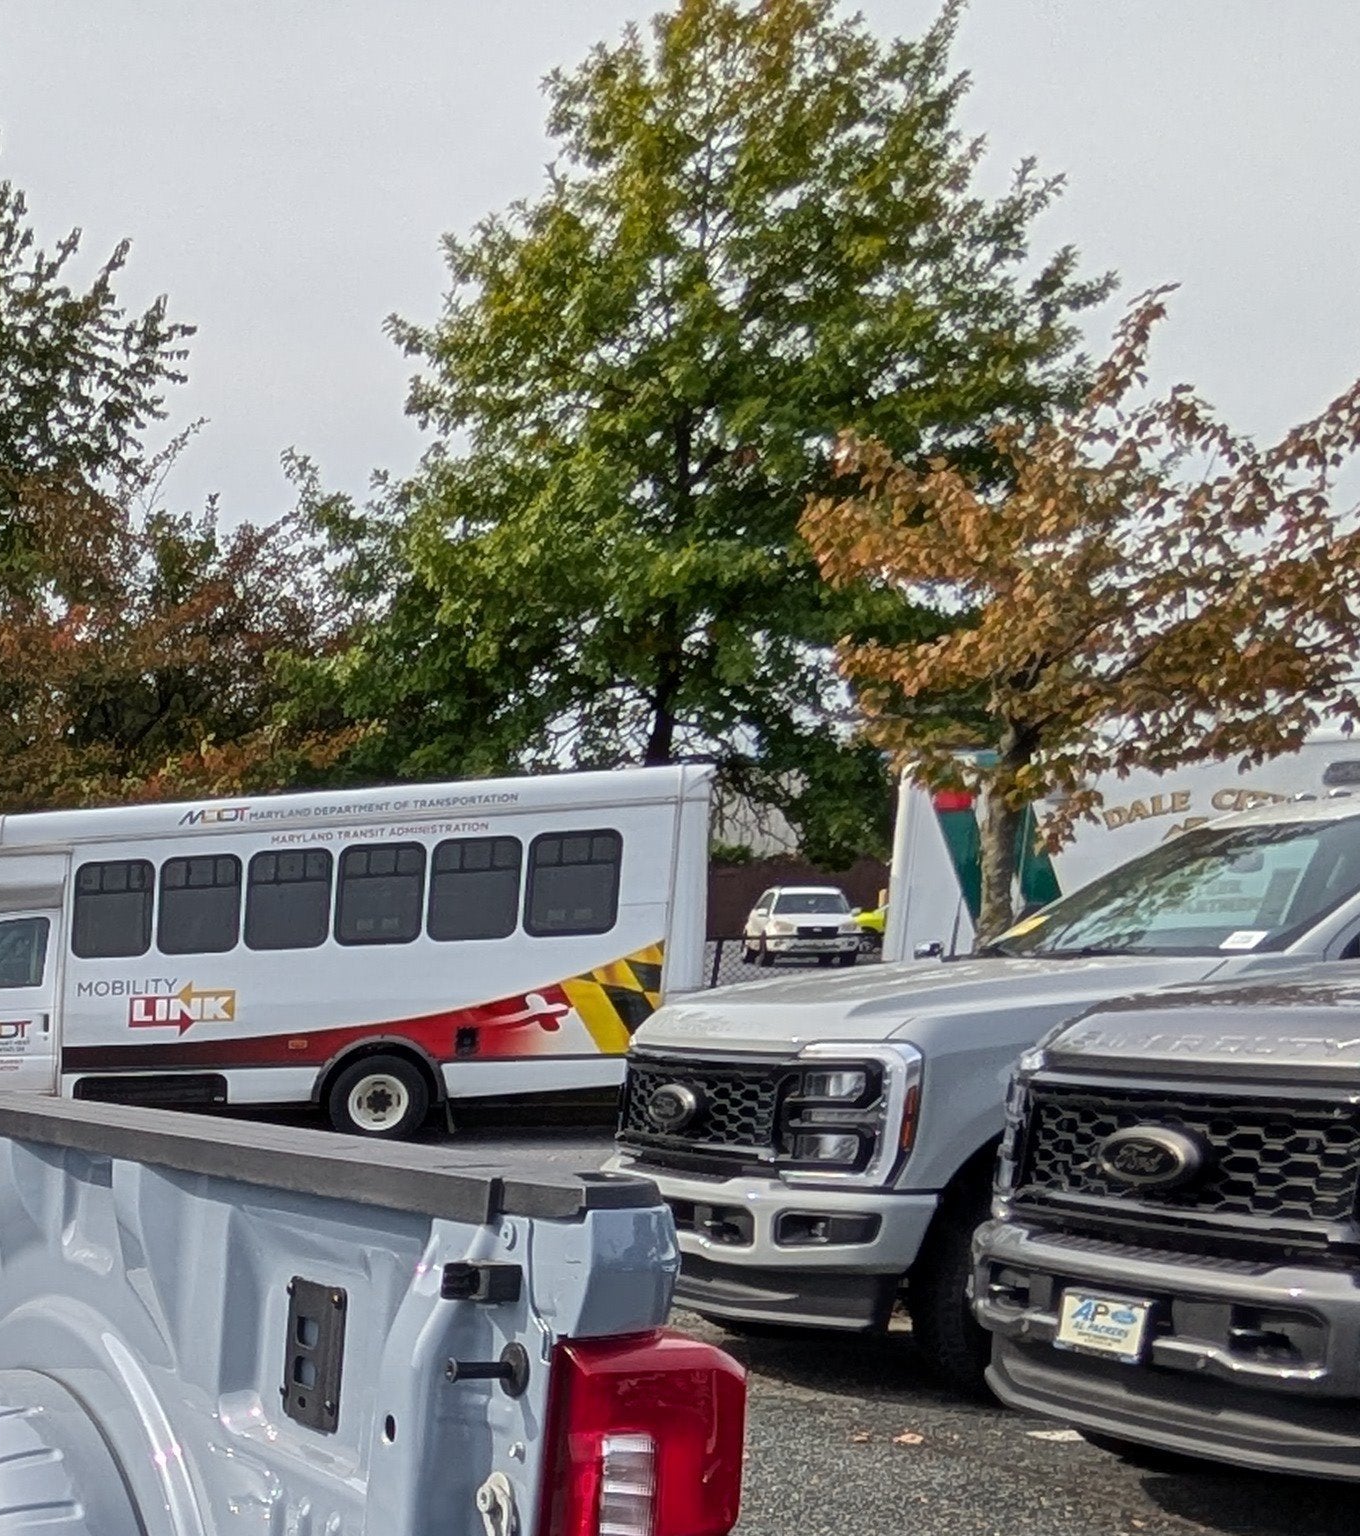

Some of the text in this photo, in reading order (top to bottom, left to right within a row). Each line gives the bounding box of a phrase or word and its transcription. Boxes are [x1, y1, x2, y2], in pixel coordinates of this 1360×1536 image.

[249, 808, 312, 821] MARYLAND
[314, 801, 391, 816] DEPARTMENT
[393, 800, 409, 812] OF
[413, 792, 520, 810] TRANSPORTATION
[1102, 789, 1192, 831] DALE
[270, 821, 490, 846] MARYLAND TRANSIT ADMINISTRATION
[76, 977, 179, 998] MOBILITY
[131, 995, 233, 1023] LINK
